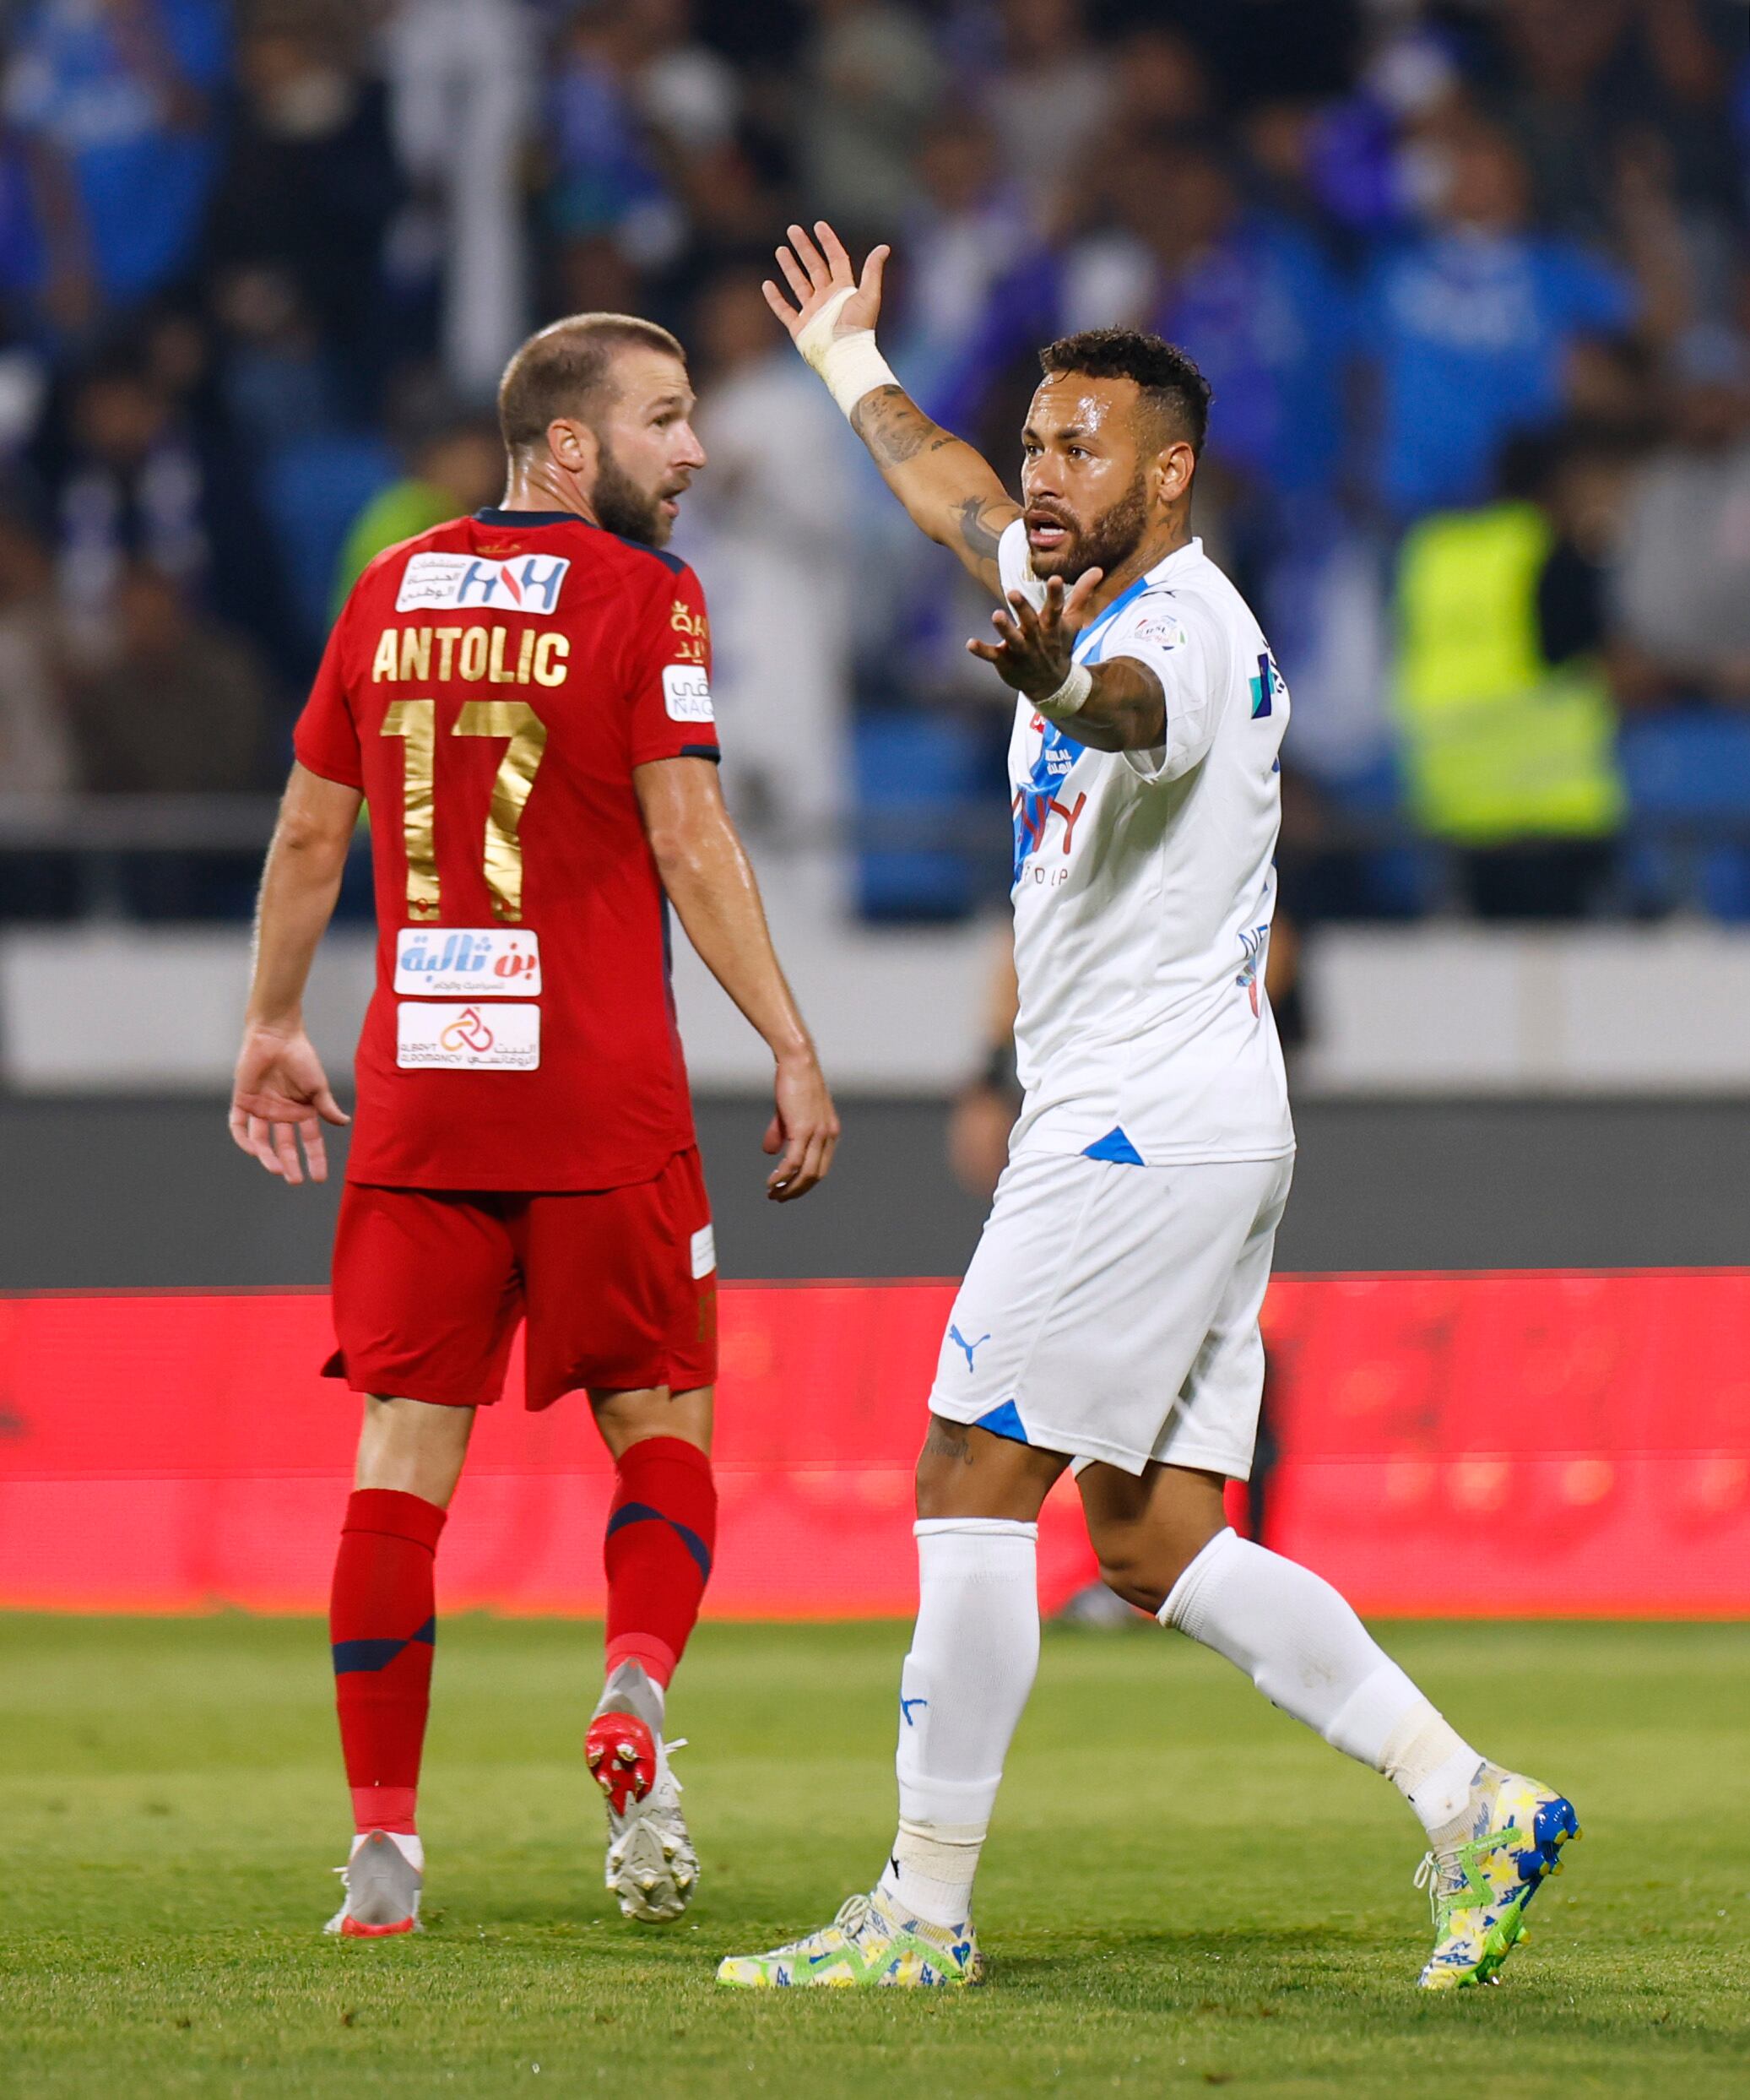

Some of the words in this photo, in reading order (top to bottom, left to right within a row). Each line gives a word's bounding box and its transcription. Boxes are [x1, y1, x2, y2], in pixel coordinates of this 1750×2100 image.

[372, 627, 570, 687] ANTOLIC
[380, 699, 548, 920] 17
[494, 942, 537, 980] بن
